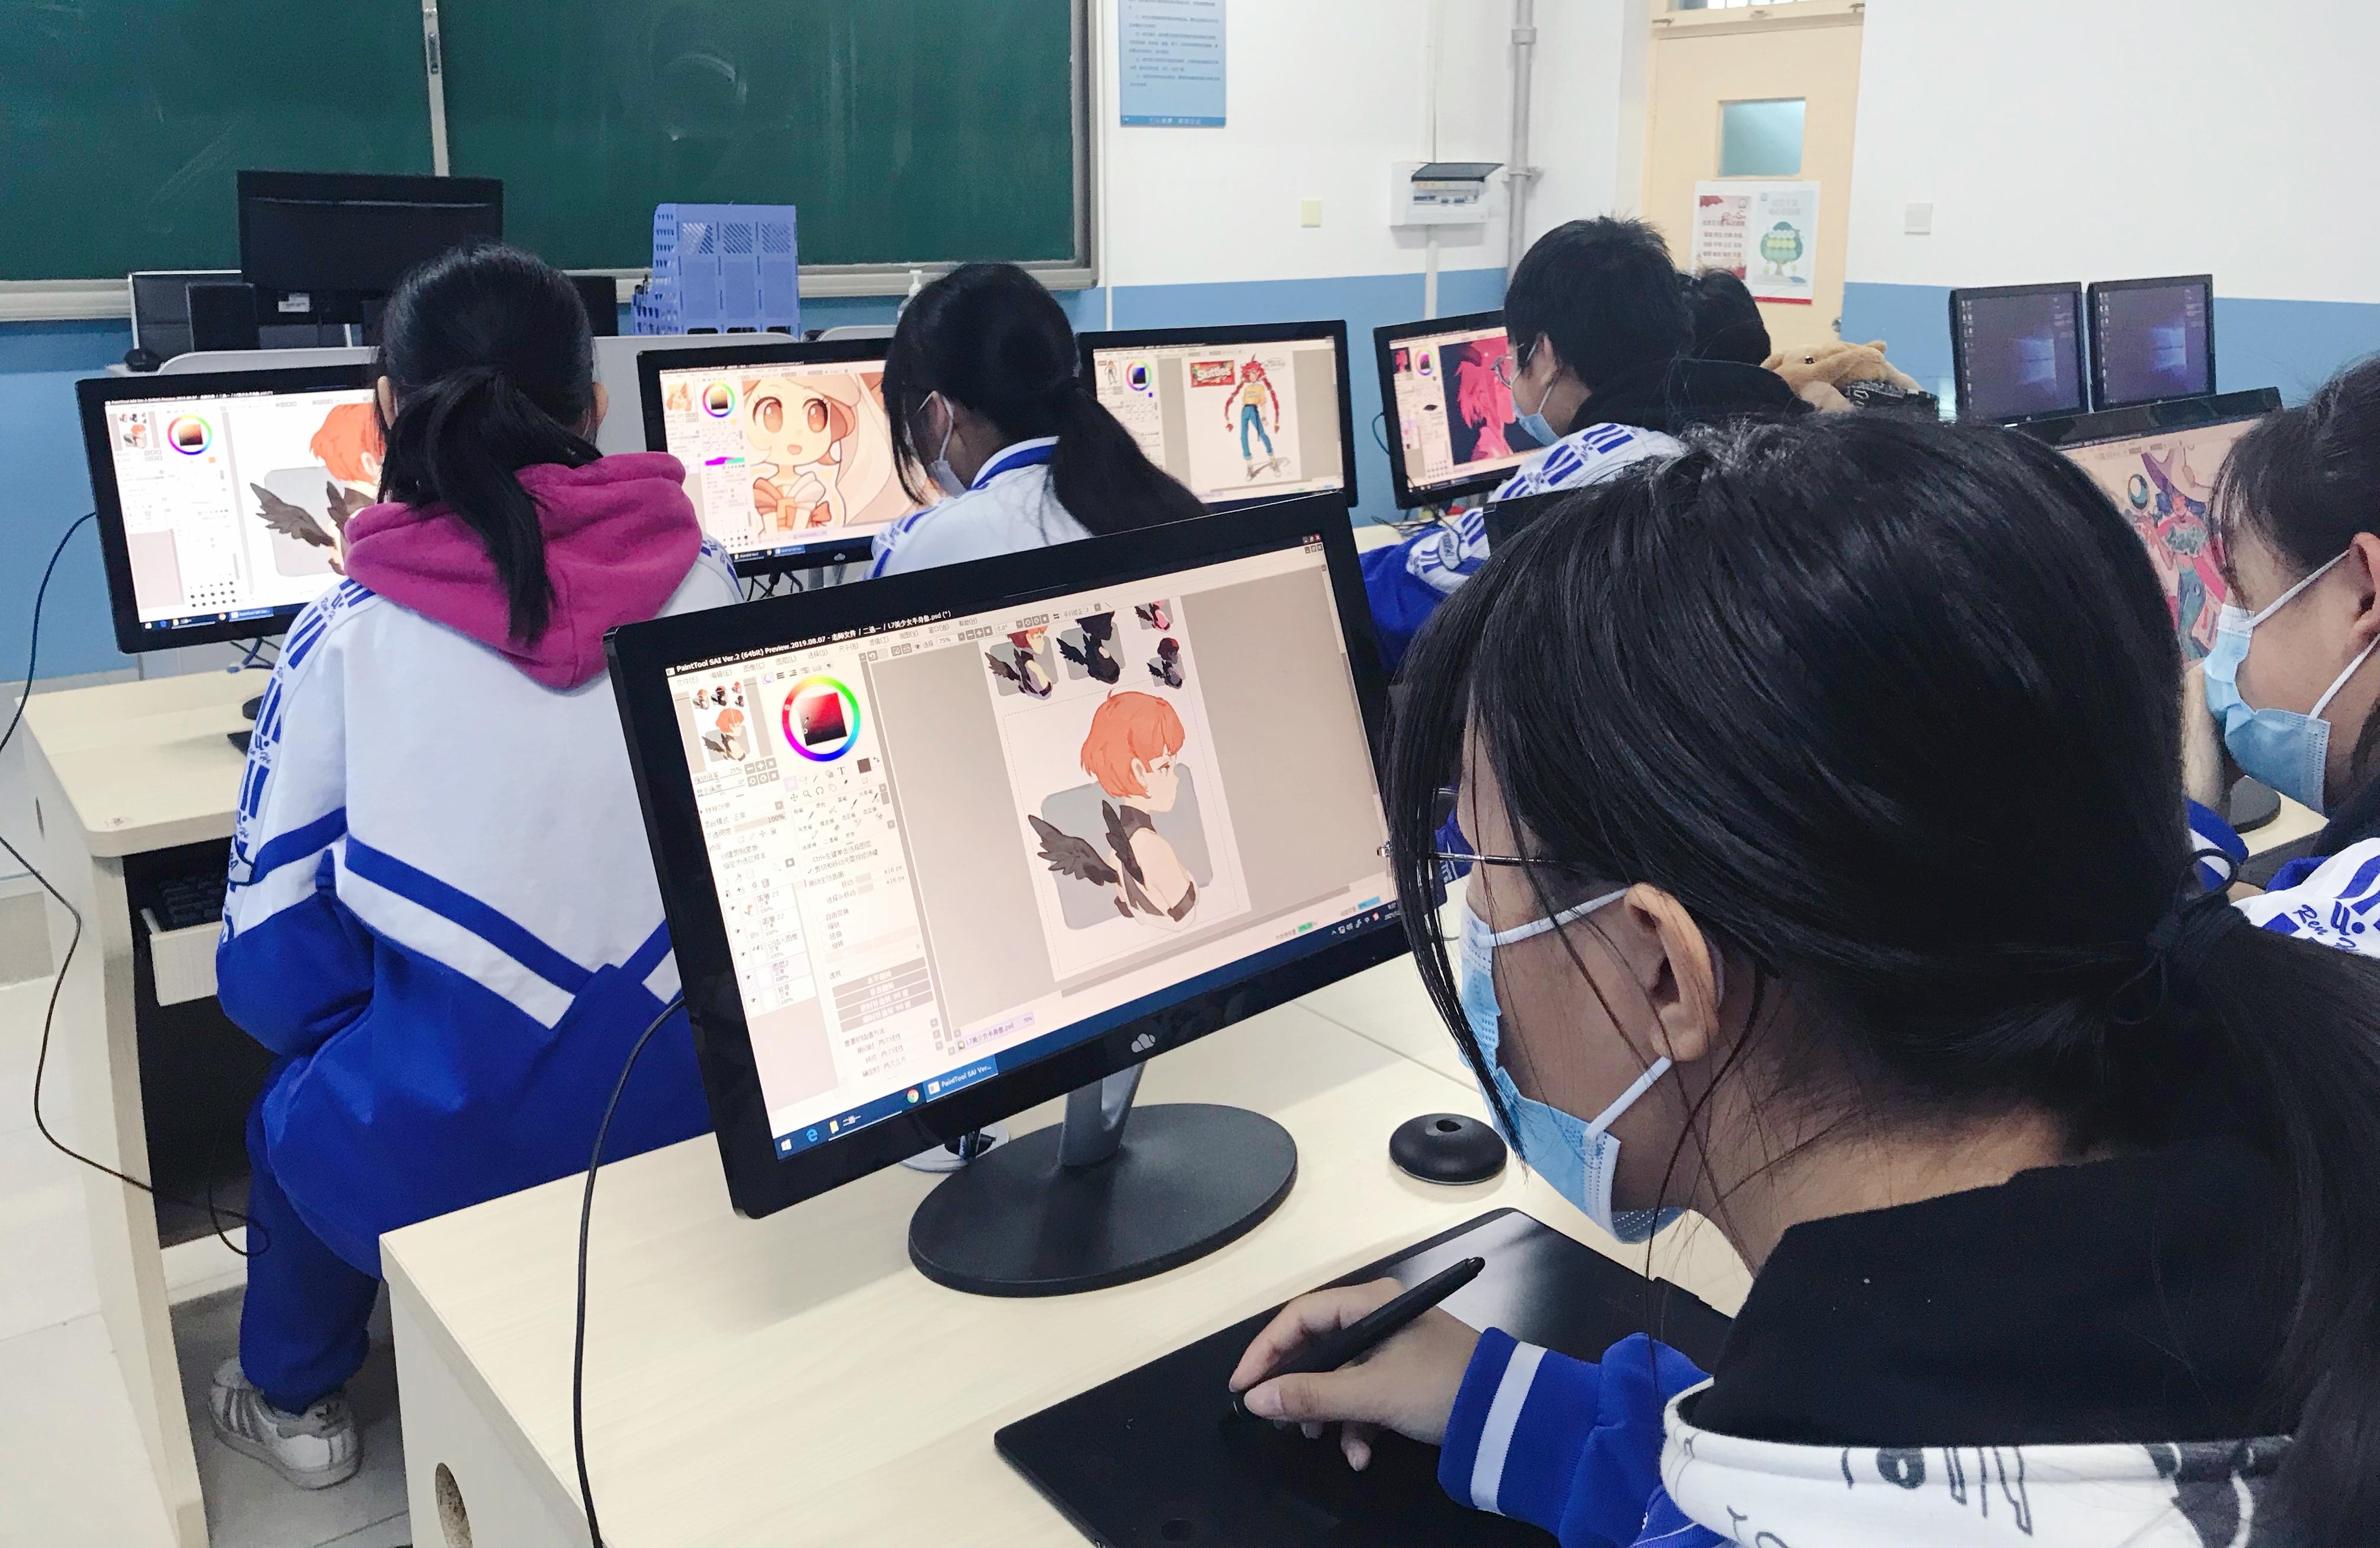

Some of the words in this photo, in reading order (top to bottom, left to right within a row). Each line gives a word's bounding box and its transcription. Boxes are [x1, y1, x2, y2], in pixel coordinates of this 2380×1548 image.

[807, 648, 828, 659] 选择(S)
[927, 623, 949, 633] 窗口(W)
[938, 636, 951, 645] 75%
[676, 659, 708, 672] PaintTool
[709, 657, 722, 665] SAI
[722, 653, 740, 662] Ver.2
[740, 648, 764, 660] (64bit)
[764, 635, 826, 655] Preview.2019.08.07
[831, 629, 856, 641] 老师文件
[862, 624, 882, 635] 二选一
[733, 811, 746, 821] 正常
[767, 813, 785, 823] 100%
[941, 1071, 967, 1089] PaintTool
